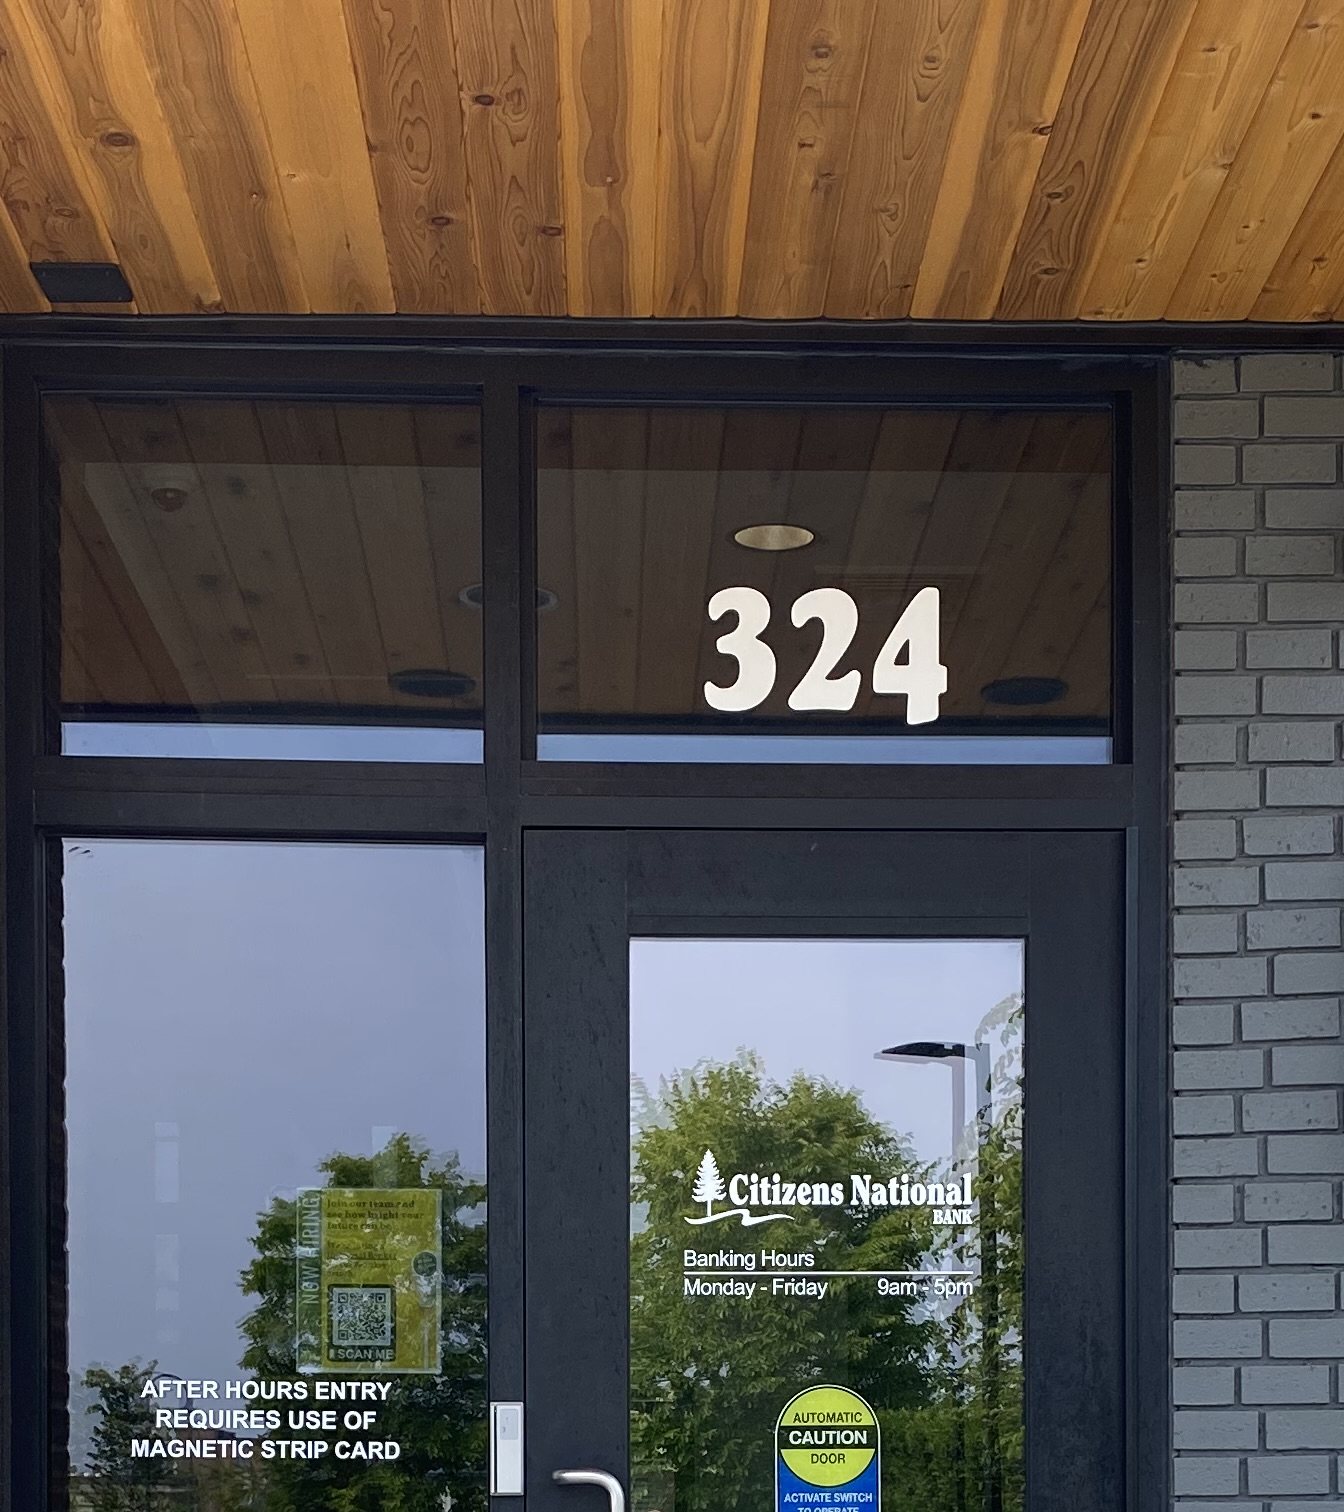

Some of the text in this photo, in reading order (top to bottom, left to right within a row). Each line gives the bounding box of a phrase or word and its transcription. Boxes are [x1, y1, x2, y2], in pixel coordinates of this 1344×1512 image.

[704, 586, 948, 725] 324
[729, 1173, 972, 1205] Citizens National
[933, 1209, 973, 1225] BANK
[301, 1197, 320, 1304] NOW HIRING
[683, 1250, 815, 1270] Banking Hours
[683, 1278, 756, 1299] Monday
[772, 1278, 828, 1299] Friday
[878, 1278, 917, 1296] 9am
[934, 1278, 974, 1299] 5pm
[337, 1348, 394, 1360] SCAN ME
[140, 1380, 393, 1401] AFTER HOURS ENTRY
[156, 1409, 377, 1430] REQUIRES USE OF
[793, 1412, 863, 1423] AUTOMATIC
[788, 1430, 868, 1445] CAUTION
[131, 1439, 401, 1460] MAGNETIC STRIP CARD
[811, 1453, 846, 1464] DOOR
[784, 1492, 873, 1503] ACTIVATE SWITCH
